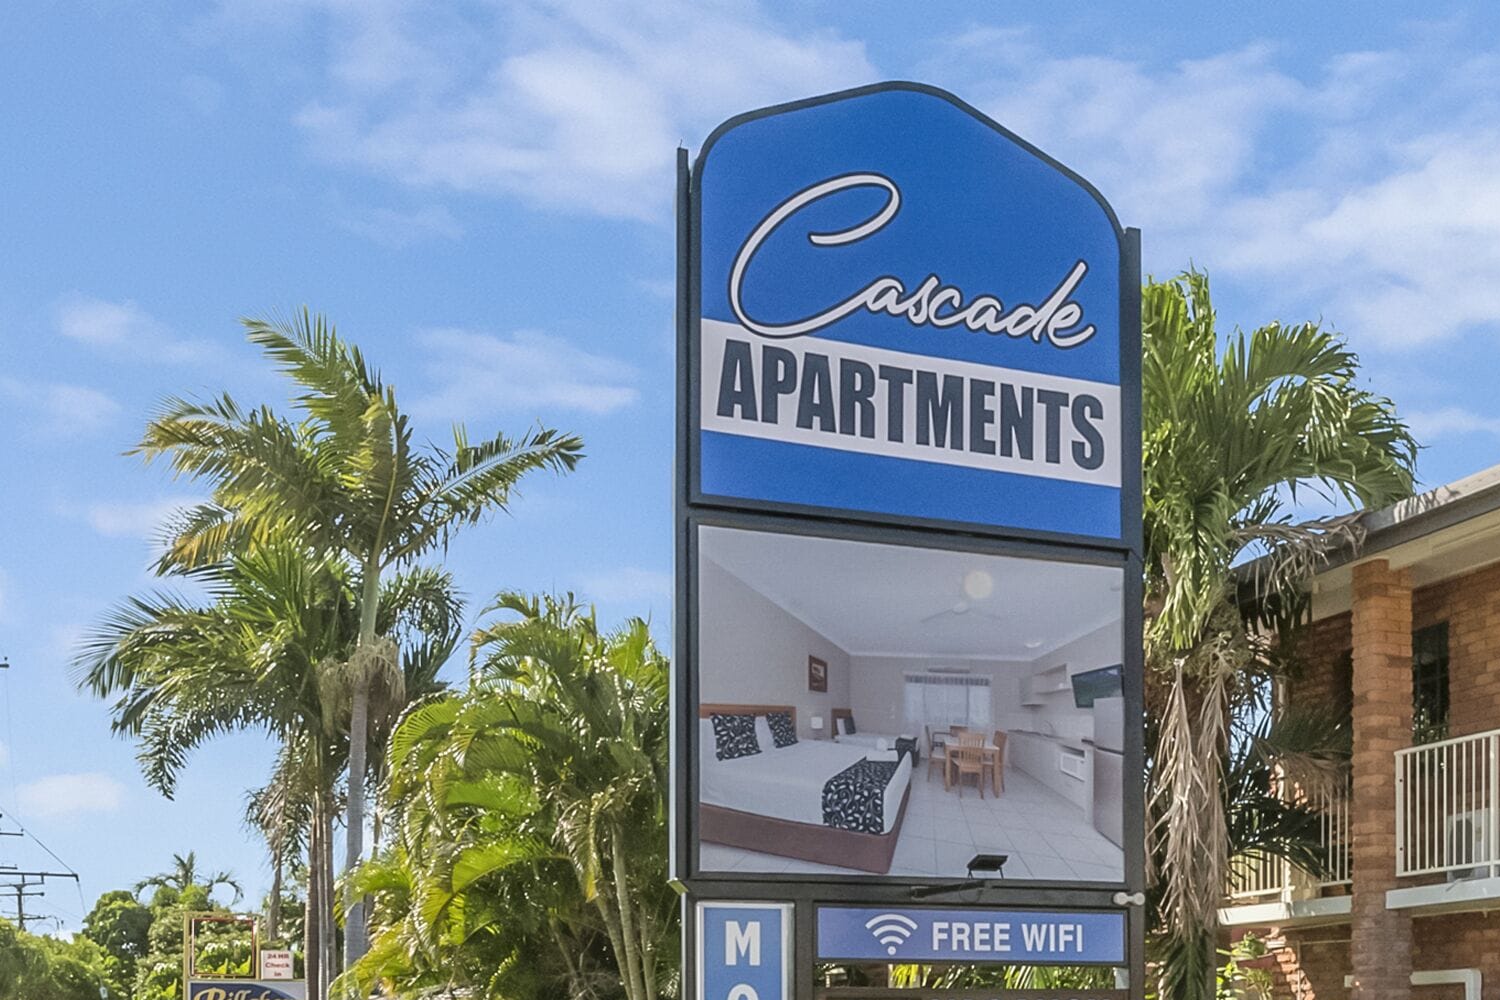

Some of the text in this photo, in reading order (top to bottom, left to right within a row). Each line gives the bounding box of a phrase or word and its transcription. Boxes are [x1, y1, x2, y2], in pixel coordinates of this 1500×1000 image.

[728, 170, 1096, 350] Cascade
[715, 338, 1106, 471] APARTMENTS
[931, 922, 1084, 953] FREE WIFI
